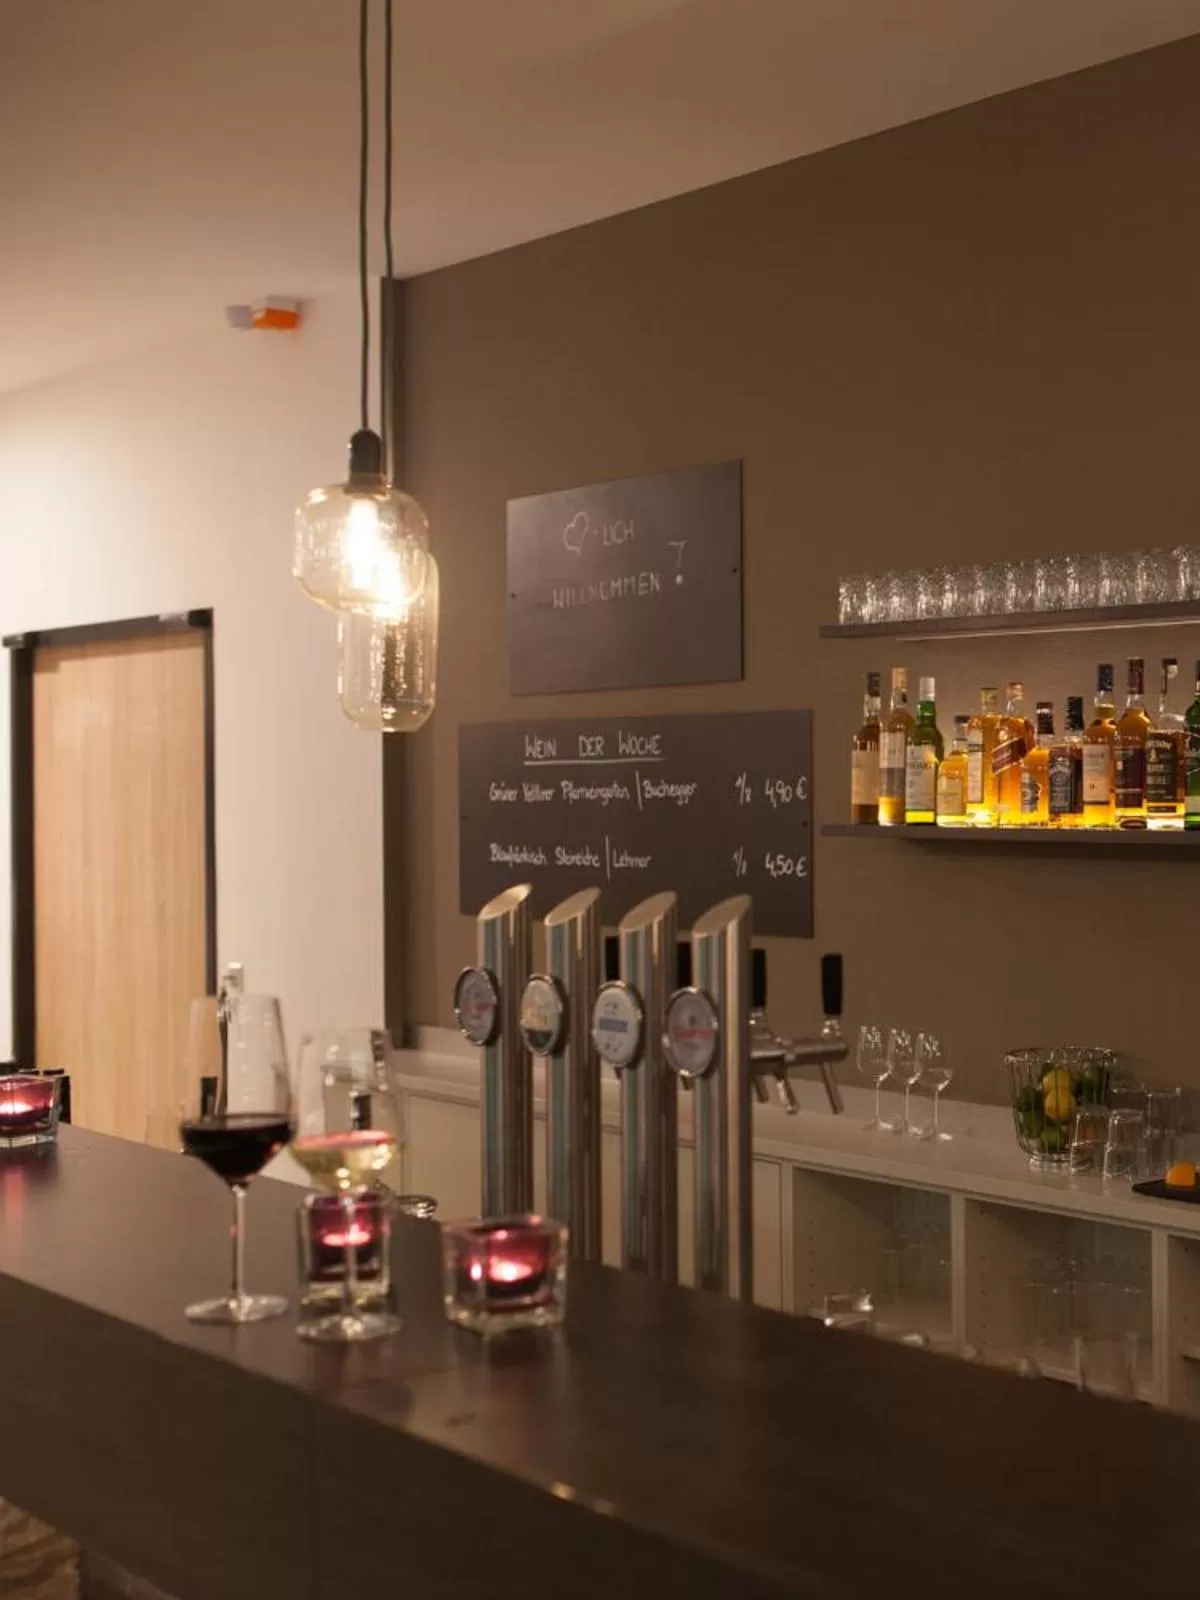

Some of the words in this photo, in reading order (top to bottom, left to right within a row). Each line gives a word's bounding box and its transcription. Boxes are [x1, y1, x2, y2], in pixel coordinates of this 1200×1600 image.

[523, 733, 557, 759] WEIN
[578, 734, 605, 758] DER
[618, 729, 662, 756] WOCHE
